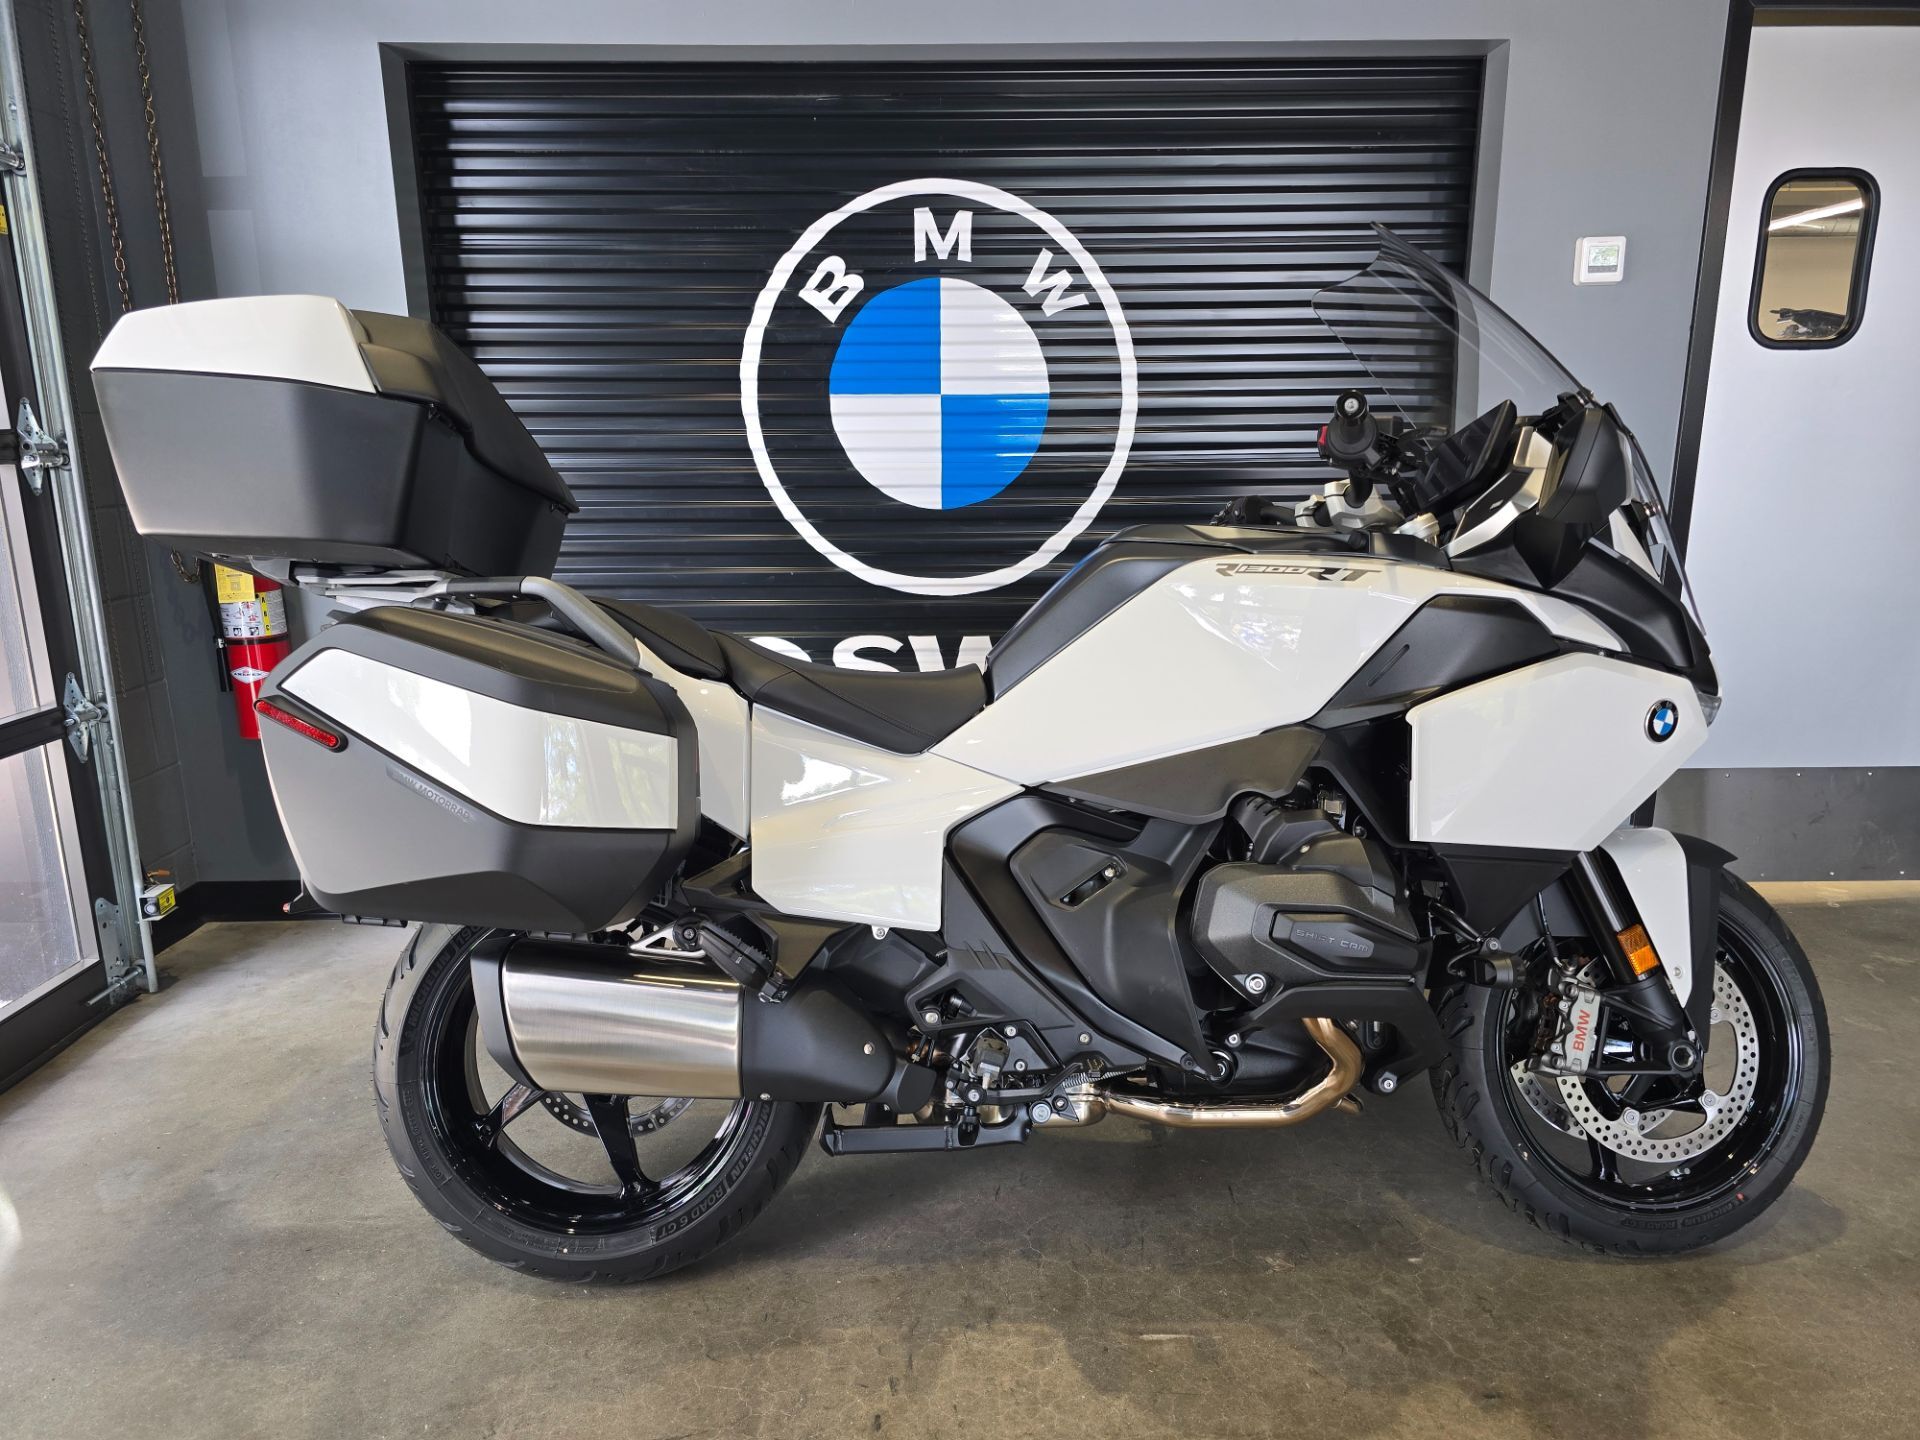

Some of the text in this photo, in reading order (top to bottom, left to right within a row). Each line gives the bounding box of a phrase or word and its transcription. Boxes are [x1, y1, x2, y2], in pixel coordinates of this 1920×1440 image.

[798, 206, 1090, 324] BMW
[417, 783, 472, 820] MOTORRAD
[408, 951, 453, 1028] MICHELIN
[1572, 1009, 1592, 1052] BMW
[730, 1101, 771, 1183] MICHELIN
[691, 1185, 725, 1219] ROAD
